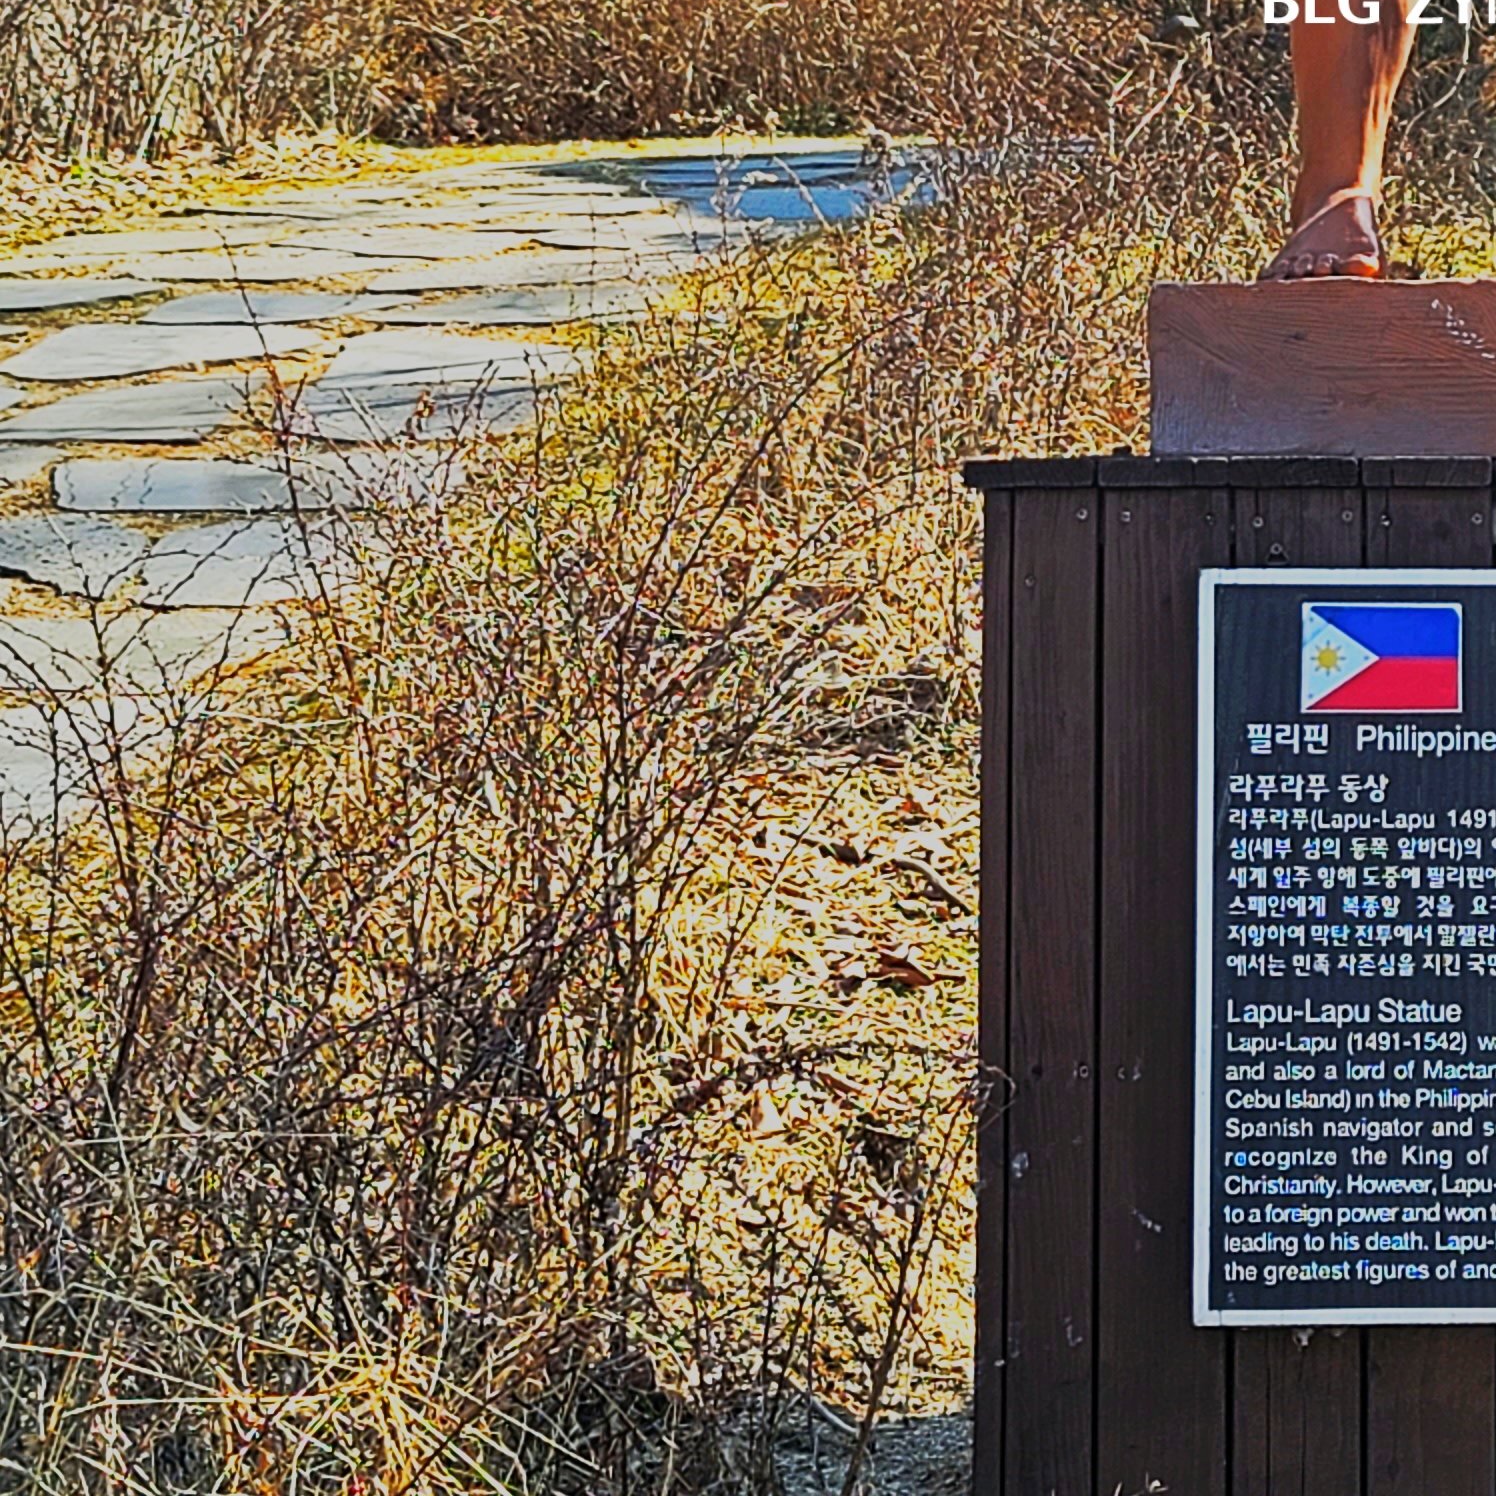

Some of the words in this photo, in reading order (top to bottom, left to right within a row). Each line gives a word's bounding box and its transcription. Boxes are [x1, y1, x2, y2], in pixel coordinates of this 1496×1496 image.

[1246, 723, 1329, 755] 필리핀
[1229, 773, 1331, 803] 라푸라푸
[1337, 773, 1389, 803] 동상
[1416, 894, 1455, 918] 것을
[1310, 924, 1351, 947] 막탄
[1226, 953, 1286, 977] 에서는
[1227, 997, 1371, 1029] Lapu-Lapu
[1377, 997, 1463, 1023] Statue
[1227, 1031, 1337, 1057] Lapu-Lapu
[1347, 1031, 1467, 1056] (1491-1542)
[1225, 1061, 1265, 1081] and
[1273, 1060, 1316, 1081] also
[1324, 1064, 1338, 1080] a
[1346, 1059, 1385, 1081] lord
[1393, 1059, 1415, 1080] of
[1225, 1088, 1281, 1109] Cebu
[1285, 1088, 1351, 1113] Island)
[1355, 1093, 1374, 1109] in
[1378, 1088, 1411, 1109] the
[1225, 1117, 1314, 1140] Spanish
[1323, 1116, 1424, 1142] navigator
[1431, 1116, 1473, 1137] and
[1224, 1147, 1337, 1171] recognize
[1351, 1145, 1388, 1166] the
[1401, 1144, 1453, 1170] King
[1466, 1144, 1489, 1165] of
[1224, 1174, 1342, 1199] Christianity.
[1346, 1173, 1437, 1197] However,
[1223, 1205, 1245, 1224] to
[1247, 1208, 1262, 1223] a
[1264, 1203, 1333, 1228] foreign
[1336, 1206, 1400, 1227] power
[1401, 1201, 1441, 1223] and
[1444, 1206, 1487, 1223] won
[1224, 1231, 1299, 1257] leading
[1303, 1232, 1325, 1252] to
[1330, 1231, 1361, 1251] his
[1365, 1230, 1429, 1251] death.
[1224, 1260, 1258, 1281] the
[1263, 1260, 1351, 1286] greatest
[1355, 1259, 1430, 1285] figures
[1435, 1259, 1457, 1281] of
